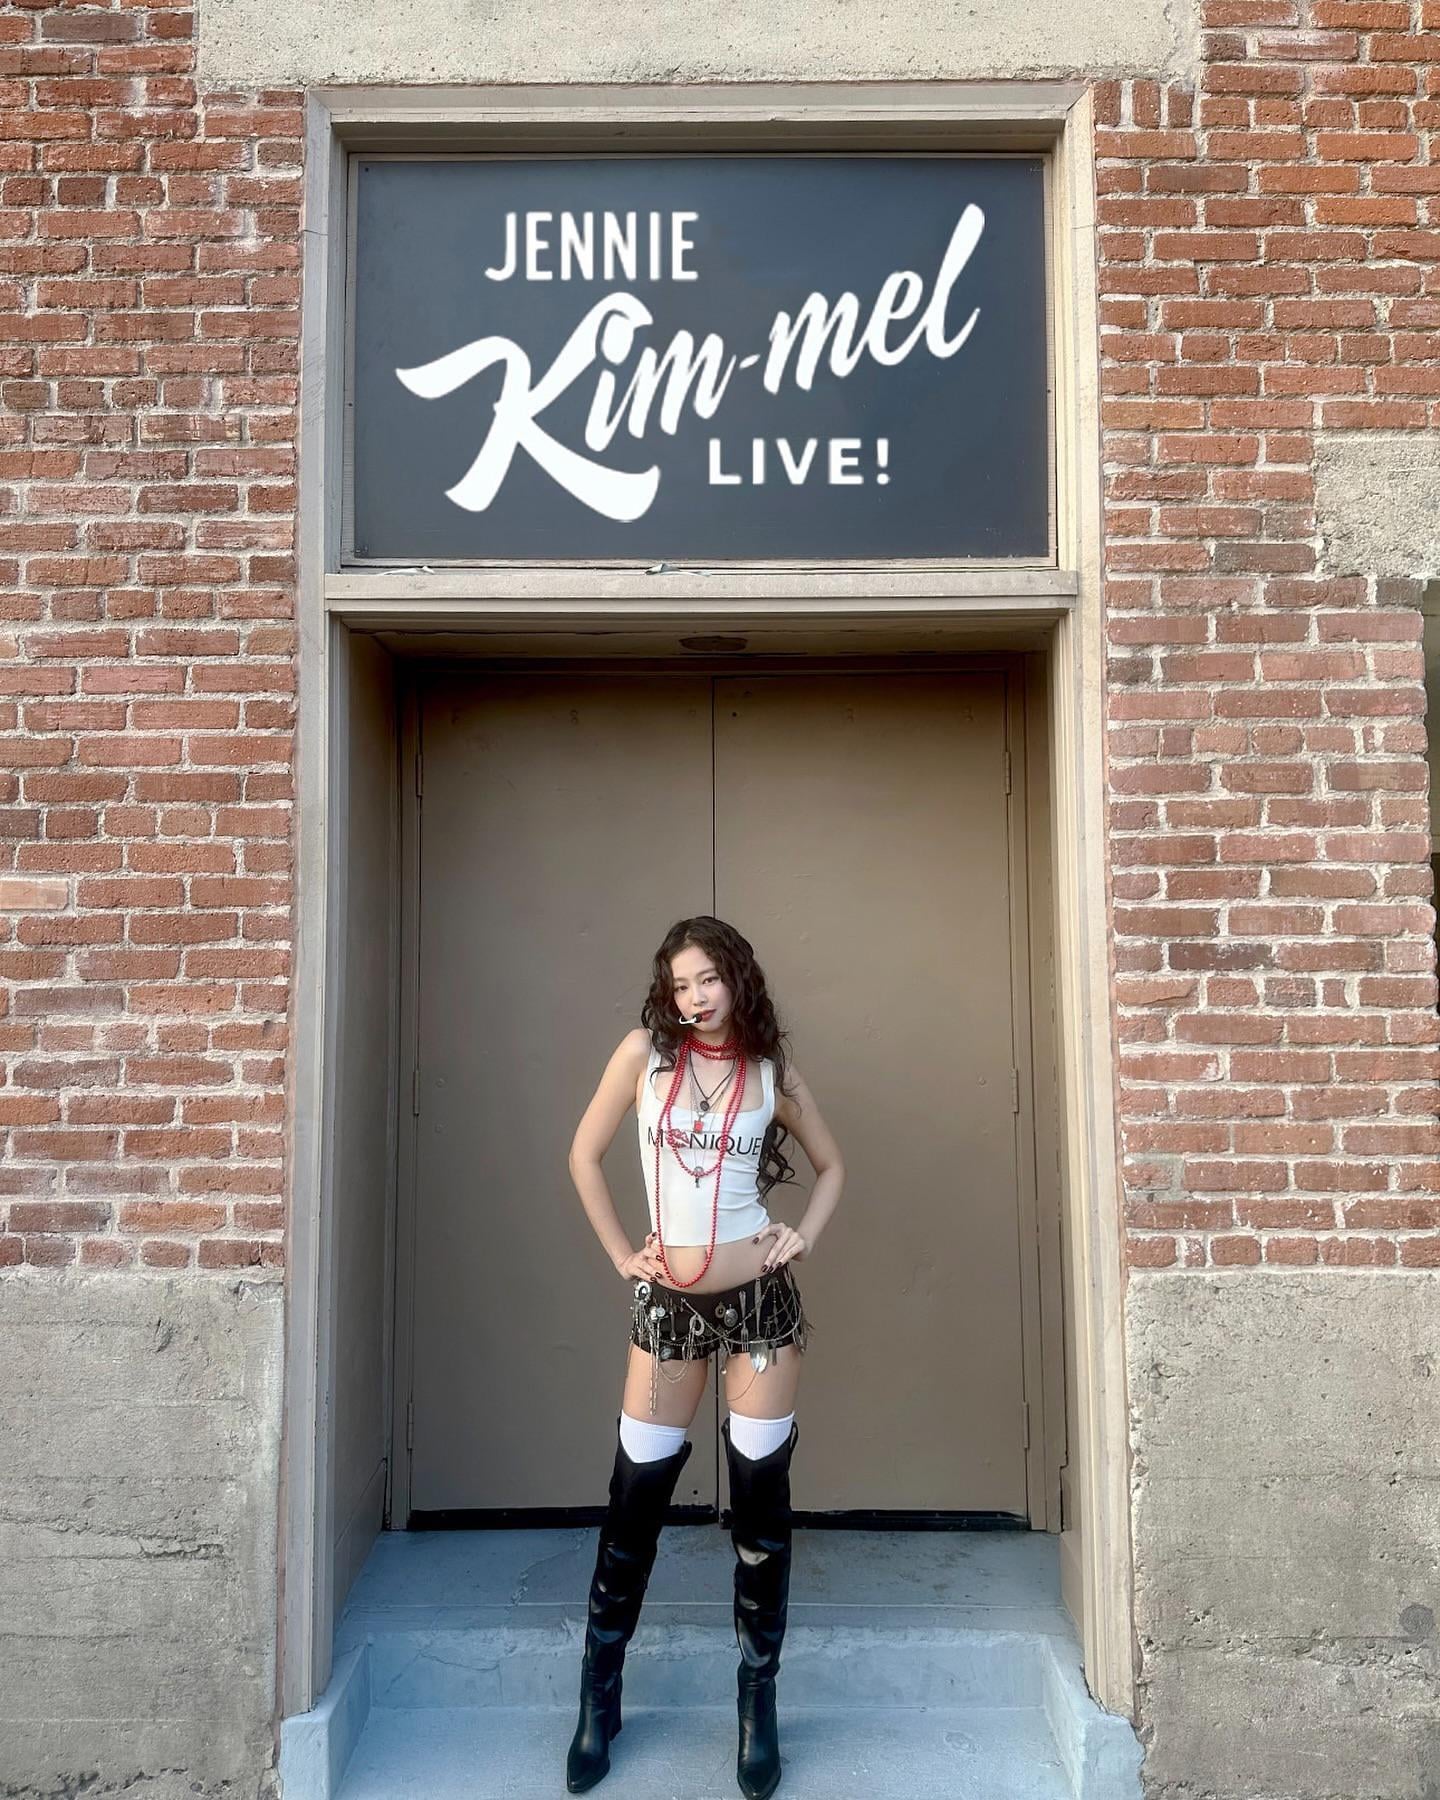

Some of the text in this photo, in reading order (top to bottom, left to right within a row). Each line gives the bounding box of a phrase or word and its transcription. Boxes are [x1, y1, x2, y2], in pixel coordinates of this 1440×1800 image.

[484, 211, 699, 281] JENNIE
[395, 203, 986, 523] Kim-mel
[708, 437, 890, 485] LIVE!
[648, 1126, 762, 1156] MNIQUE
